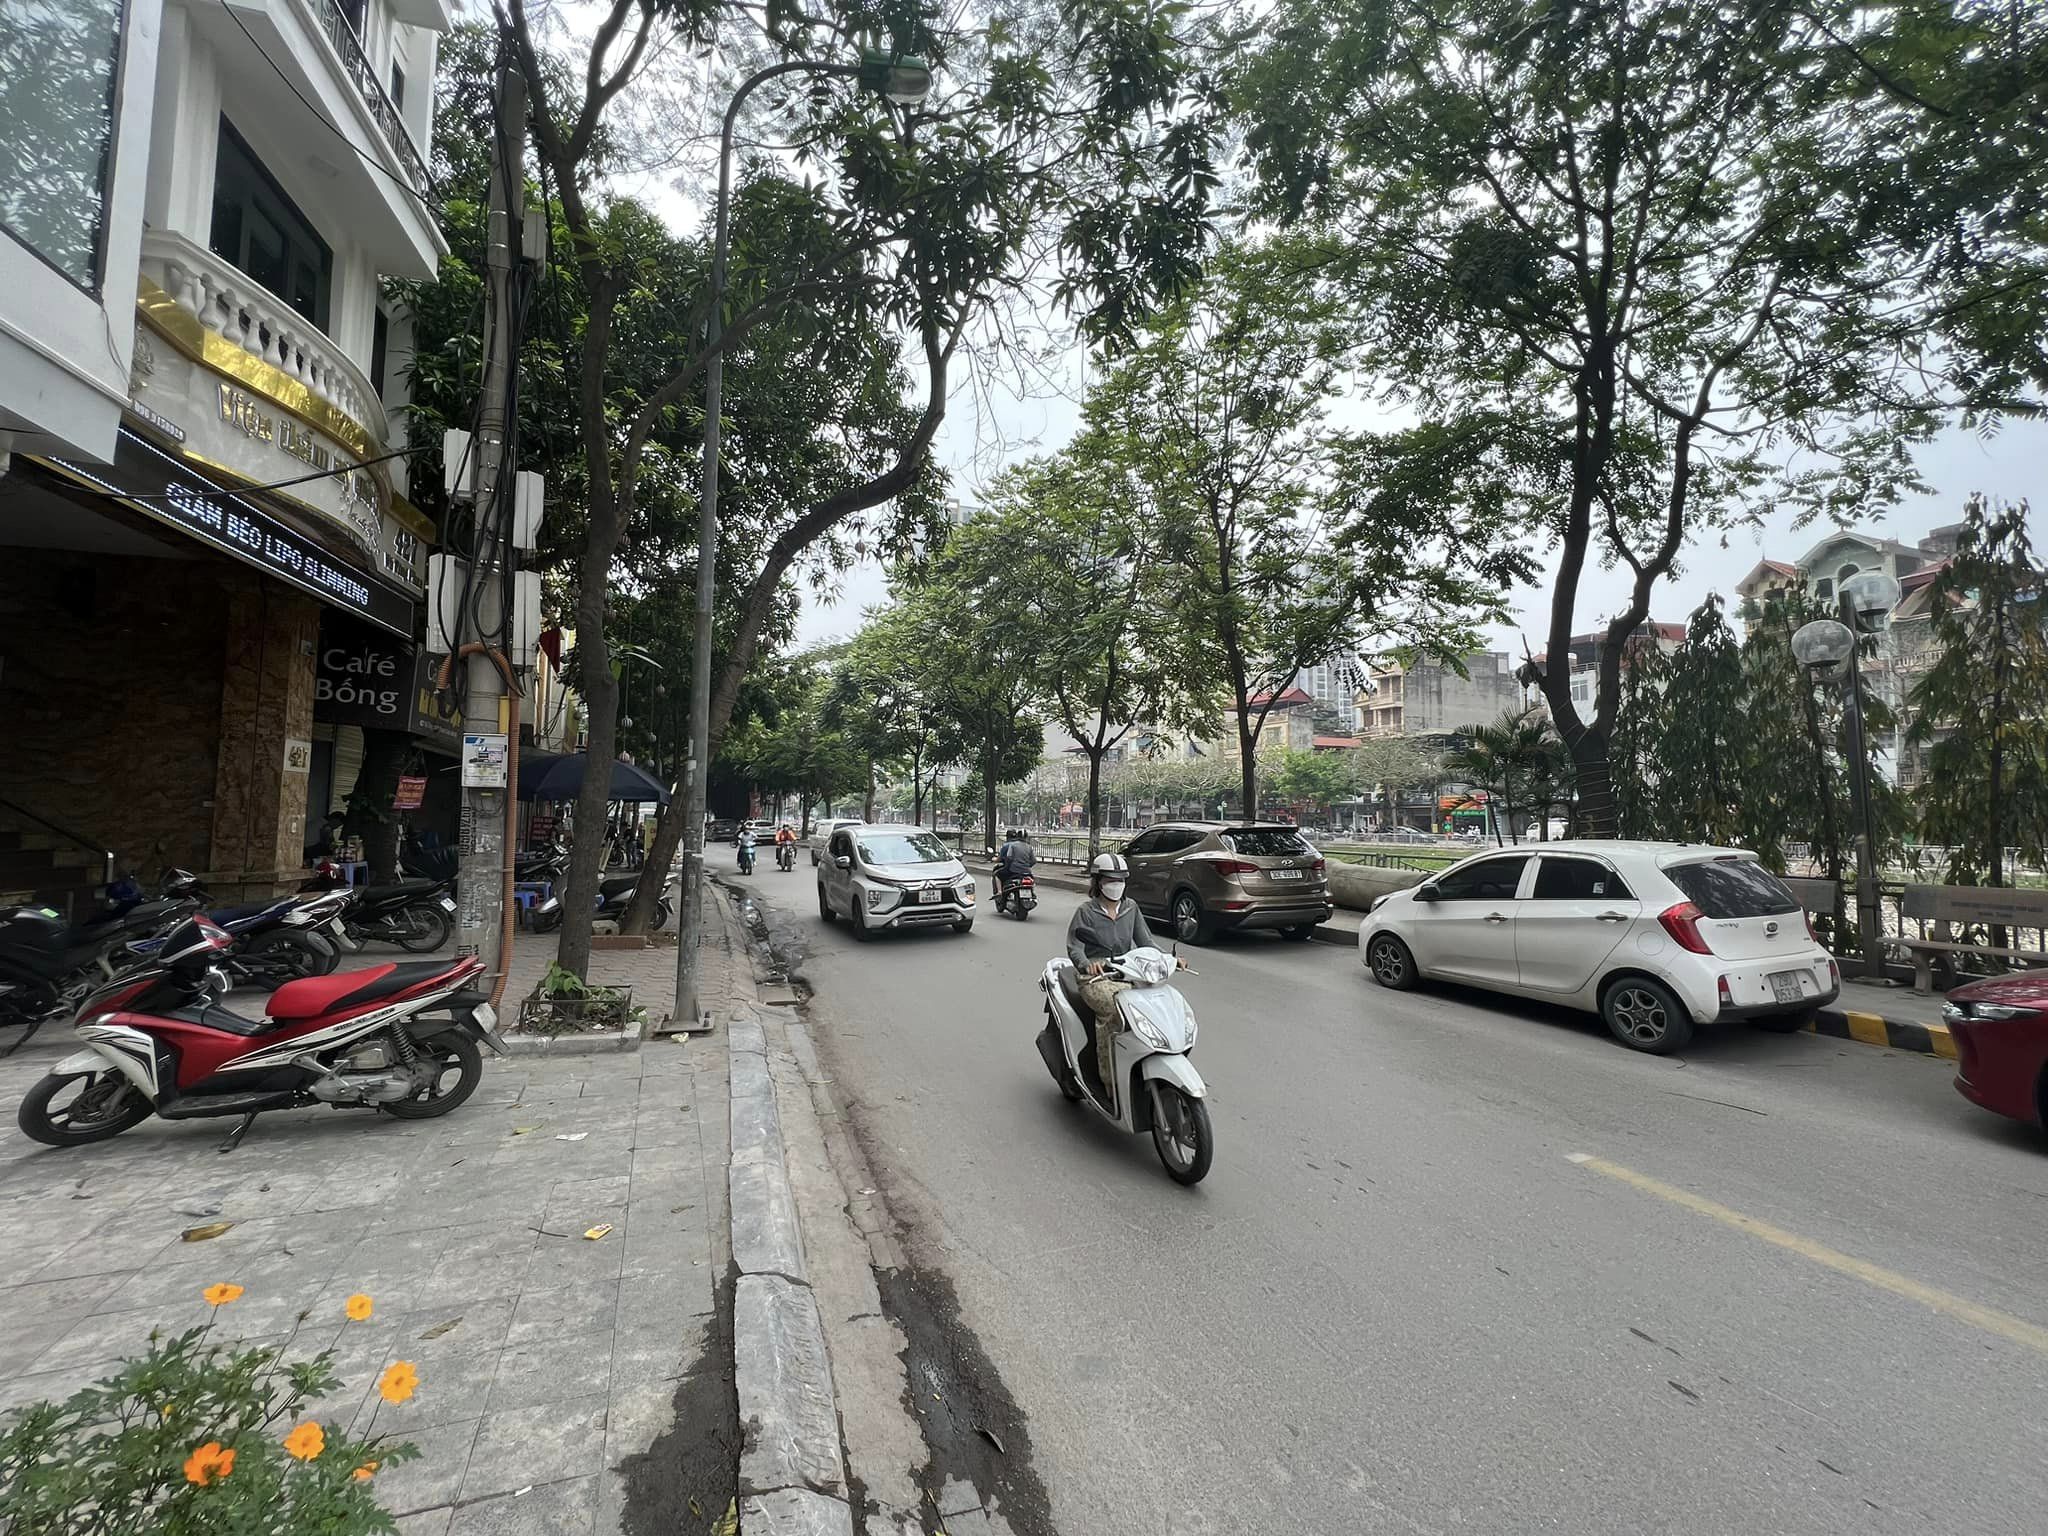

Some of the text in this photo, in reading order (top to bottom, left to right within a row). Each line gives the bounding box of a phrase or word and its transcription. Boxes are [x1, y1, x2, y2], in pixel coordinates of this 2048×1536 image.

[227, 513, 262, 549] BÉO
[264, 534, 302, 570] LIPO
[304, 556, 369, 606] SLIMMING
[323, 648, 396, 677] Café
[315, 677, 399, 714] Bống
